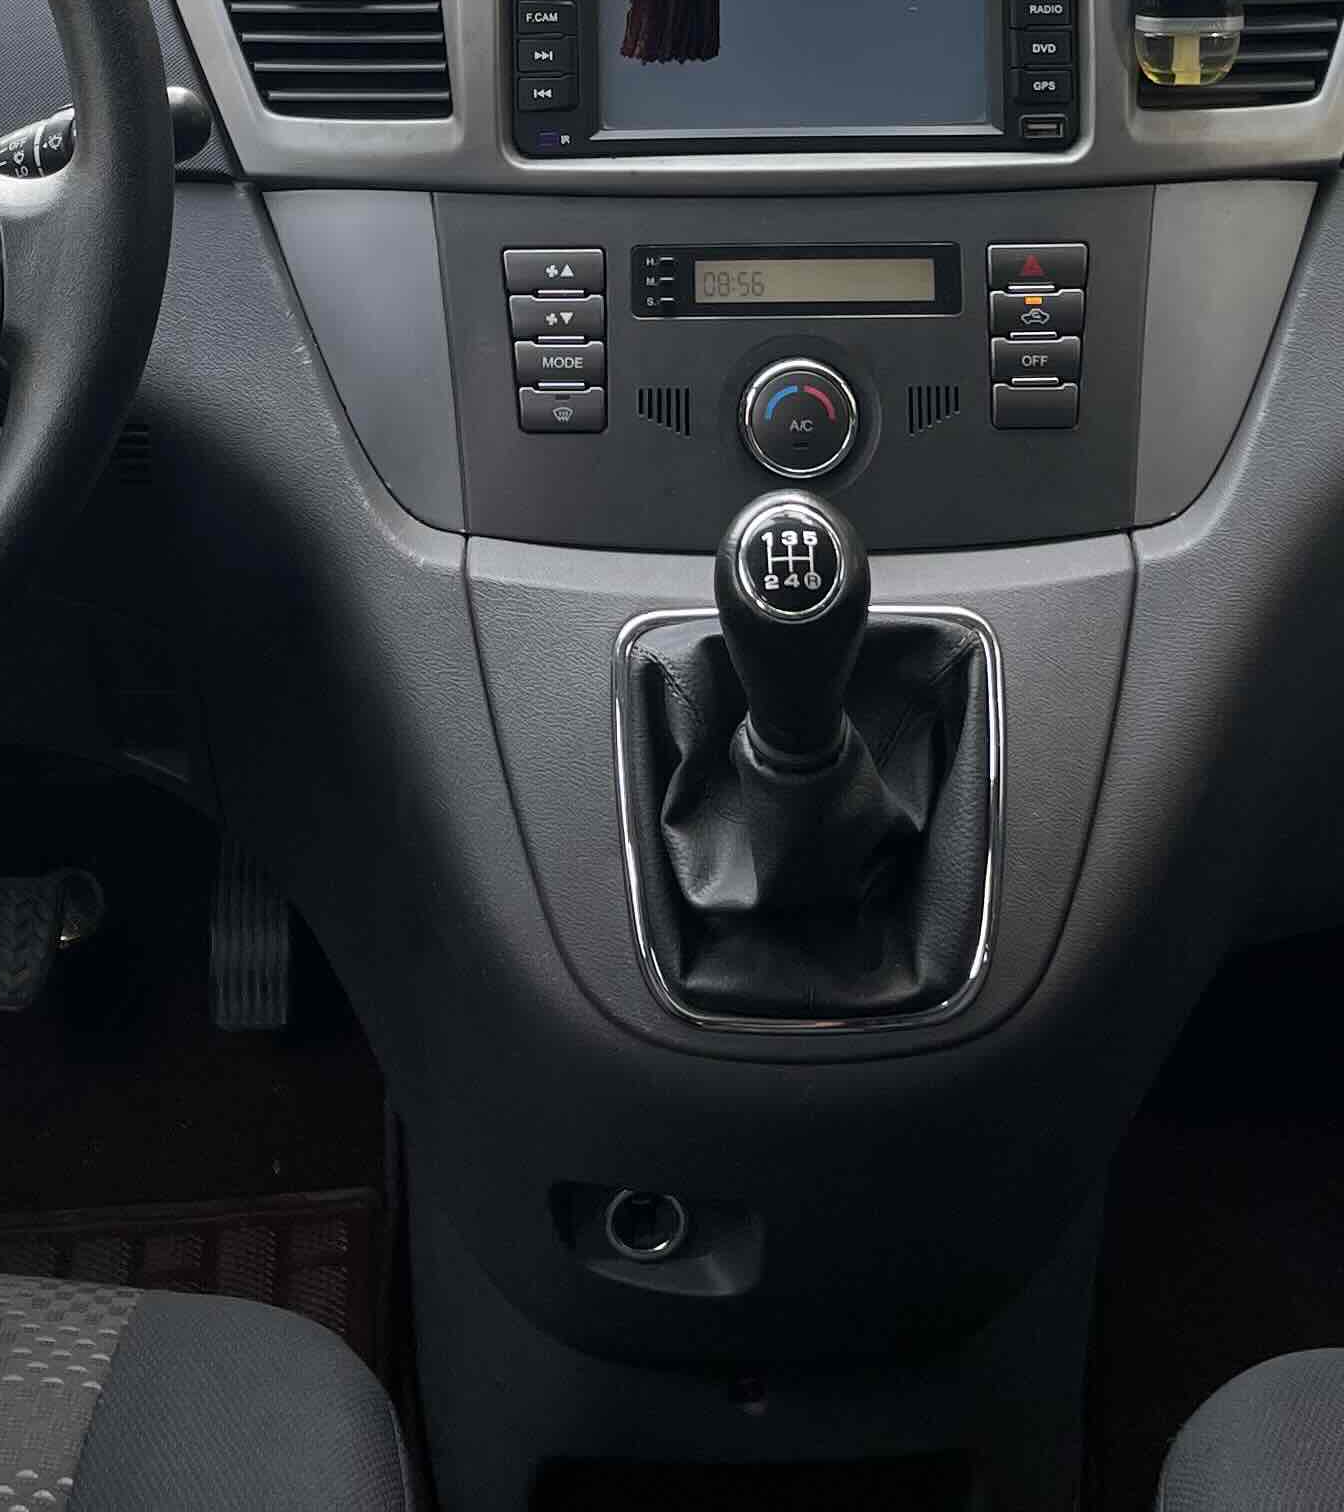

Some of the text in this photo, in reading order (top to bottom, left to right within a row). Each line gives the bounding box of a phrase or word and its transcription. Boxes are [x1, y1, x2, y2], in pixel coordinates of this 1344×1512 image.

[1029, 4, 1063, 14] RADIO
[526, 12, 558, 23] F.CAM
[1032, 43, 1057, 54] DVD
[1033, 81, 1057, 91] GPS
[703, 271, 766, 297] 08:56
[542, 356, 583, 368] MODE
[1022, 355, 1048, 367] OFF
[789, 419, 814, 432] A/C
[781, 530, 798, 545] 3
[803, 530, 818, 545] 5
[764, 574, 780, 590] 2
[784, 574, 800, 588] 4
